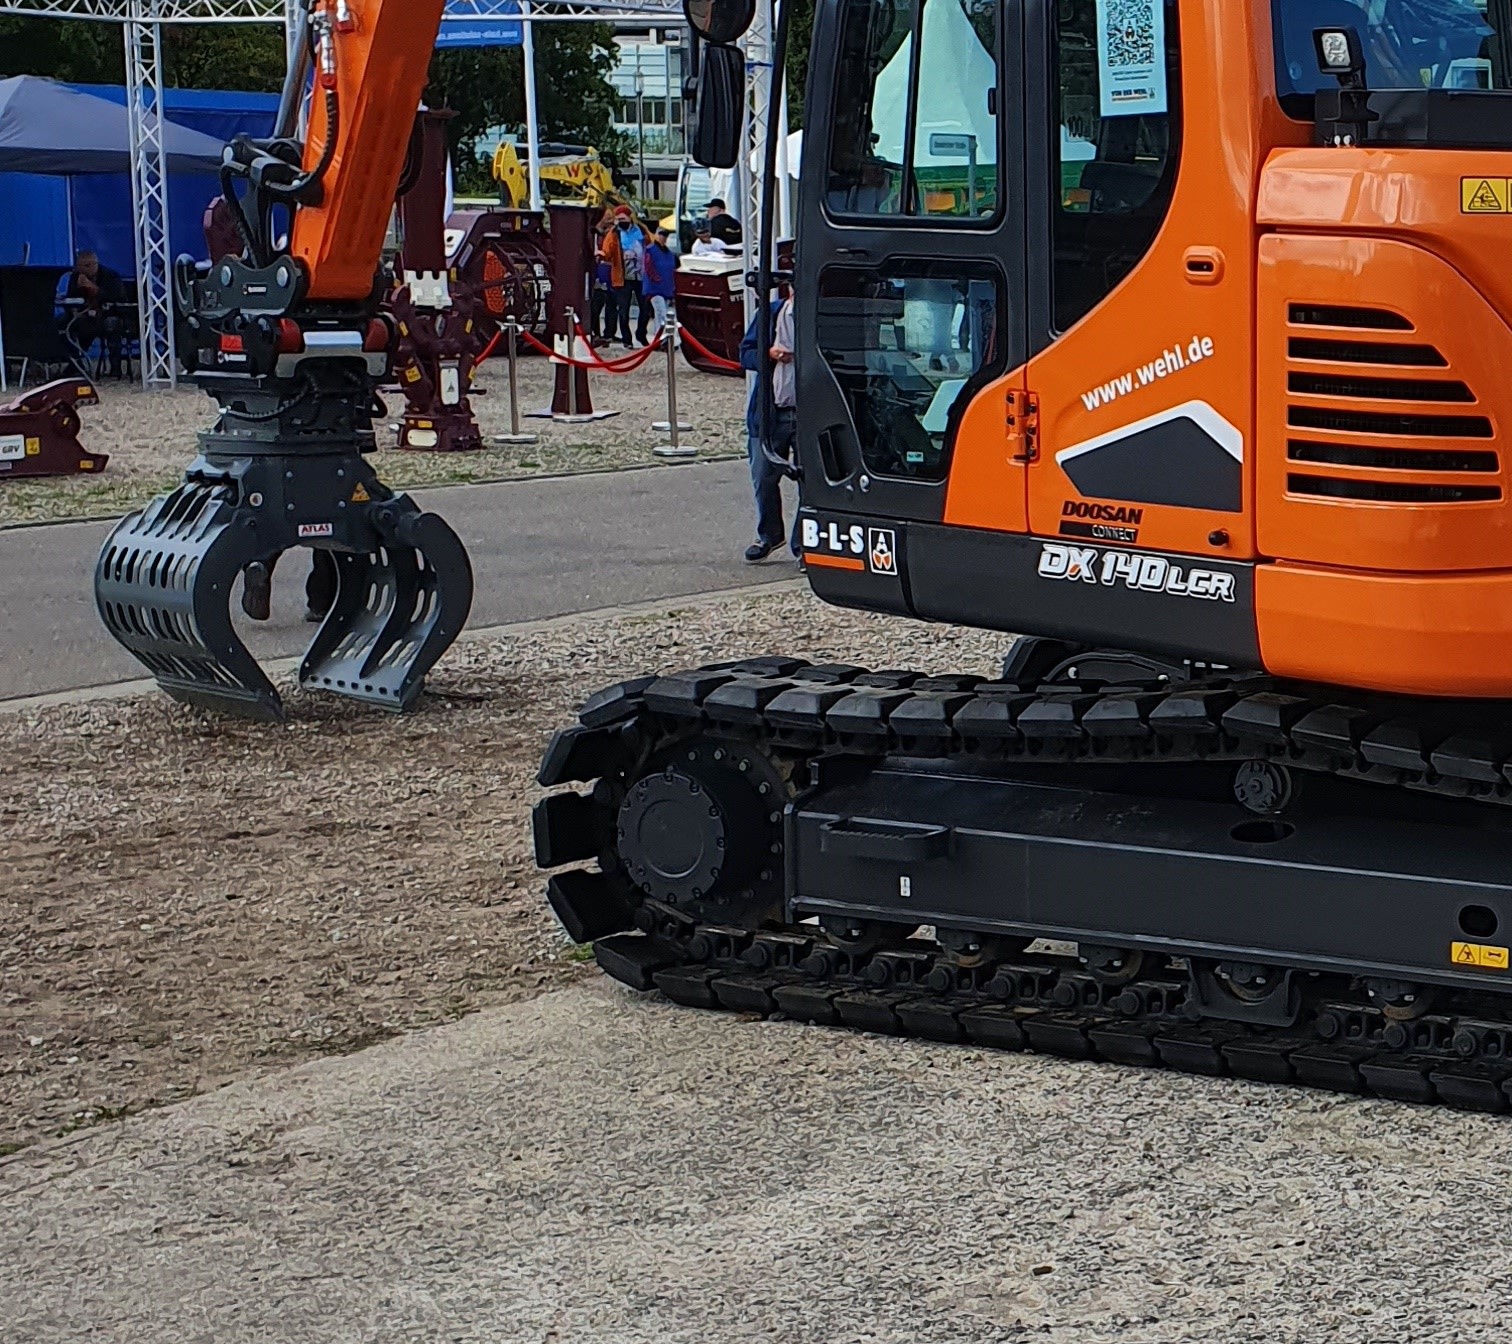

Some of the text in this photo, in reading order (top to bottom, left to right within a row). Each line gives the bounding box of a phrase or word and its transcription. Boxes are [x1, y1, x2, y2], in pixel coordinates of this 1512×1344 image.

[1080, 335, 1214, 411] www.wehl.de
[1062, 500, 1144, 525] DOOSAN
[301, 524, 330, 534] ATLAS
[802, 518, 865, 554] B-L-S
[1091, 524, 1137, 542] CONNECT
